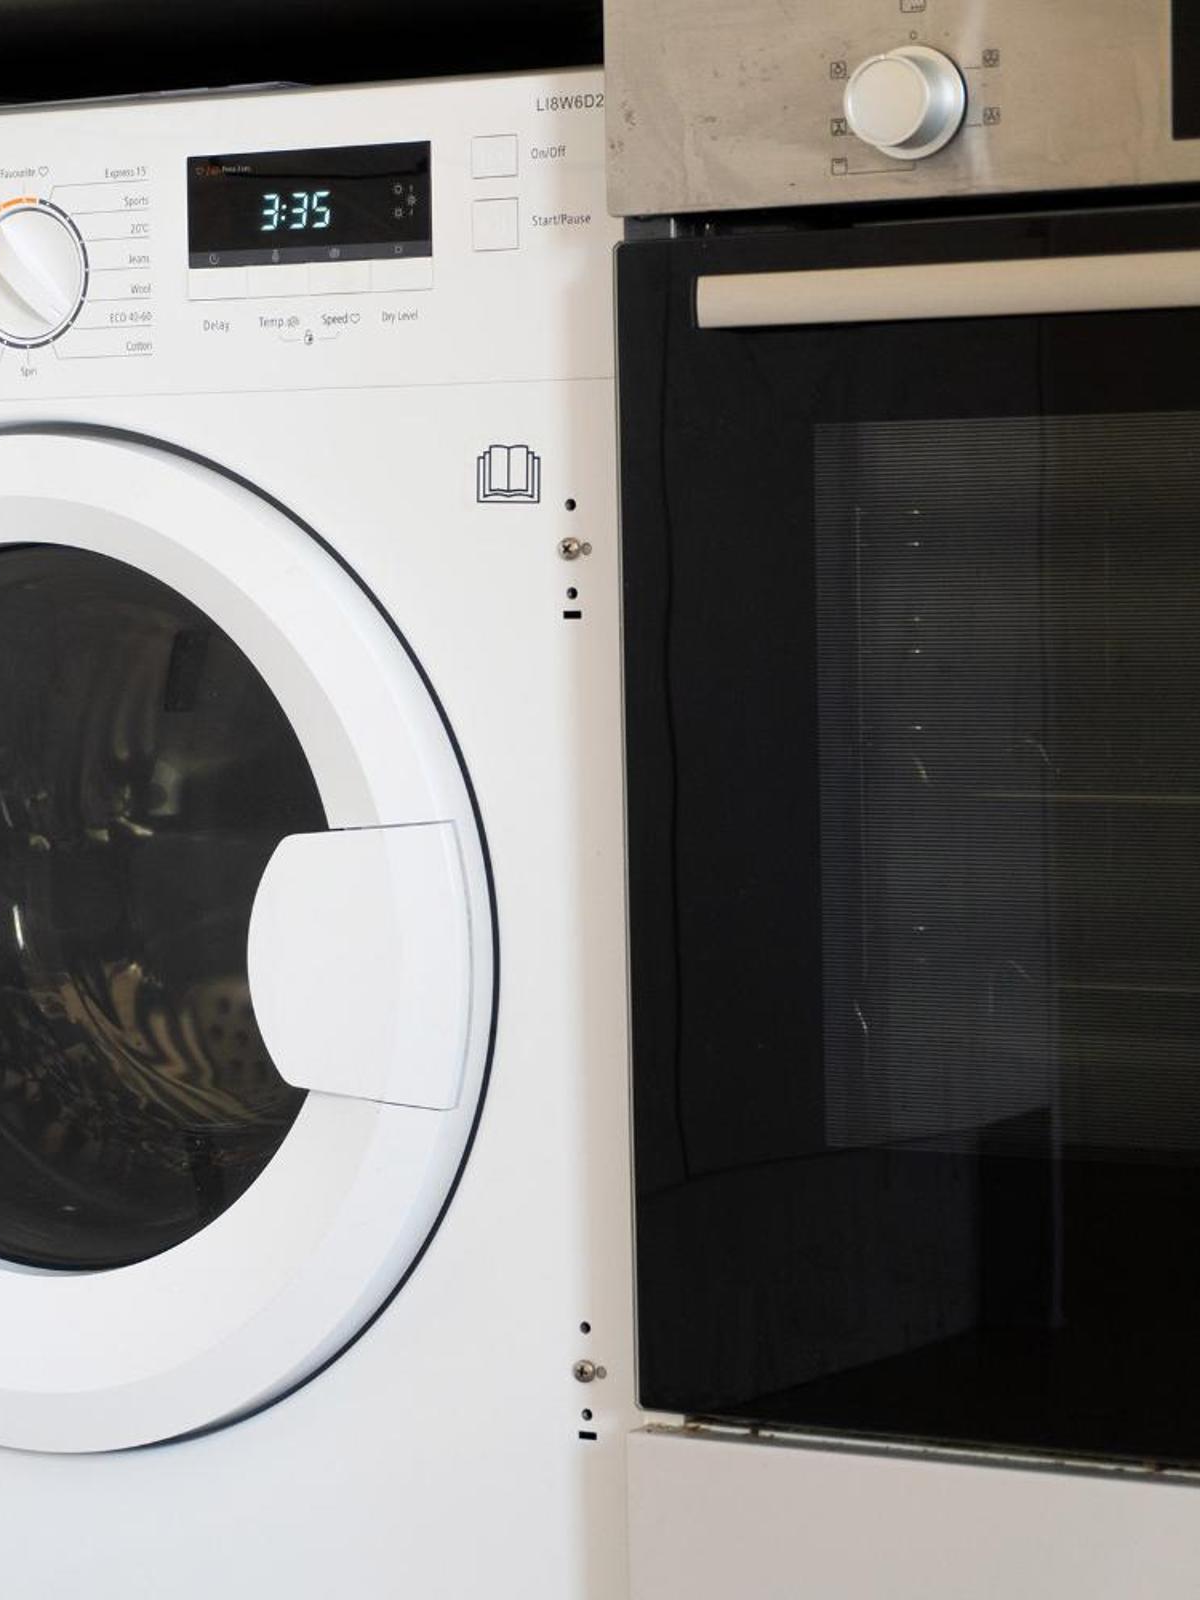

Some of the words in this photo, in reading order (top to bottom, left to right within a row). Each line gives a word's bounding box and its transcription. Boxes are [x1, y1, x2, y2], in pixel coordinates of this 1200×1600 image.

[530, 145, 566, 160] On/Off
[260, 190, 331, 231] 3:35
[531, 213, 592, 228] Start/Pause
[321, 312, 349, 327] Speed
[381, 310, 396, 324] Dry
[397, 308, 419, 321] Level
[202, 318, 230, 333] Delay
[125, 340, 153, 352] Cotton
